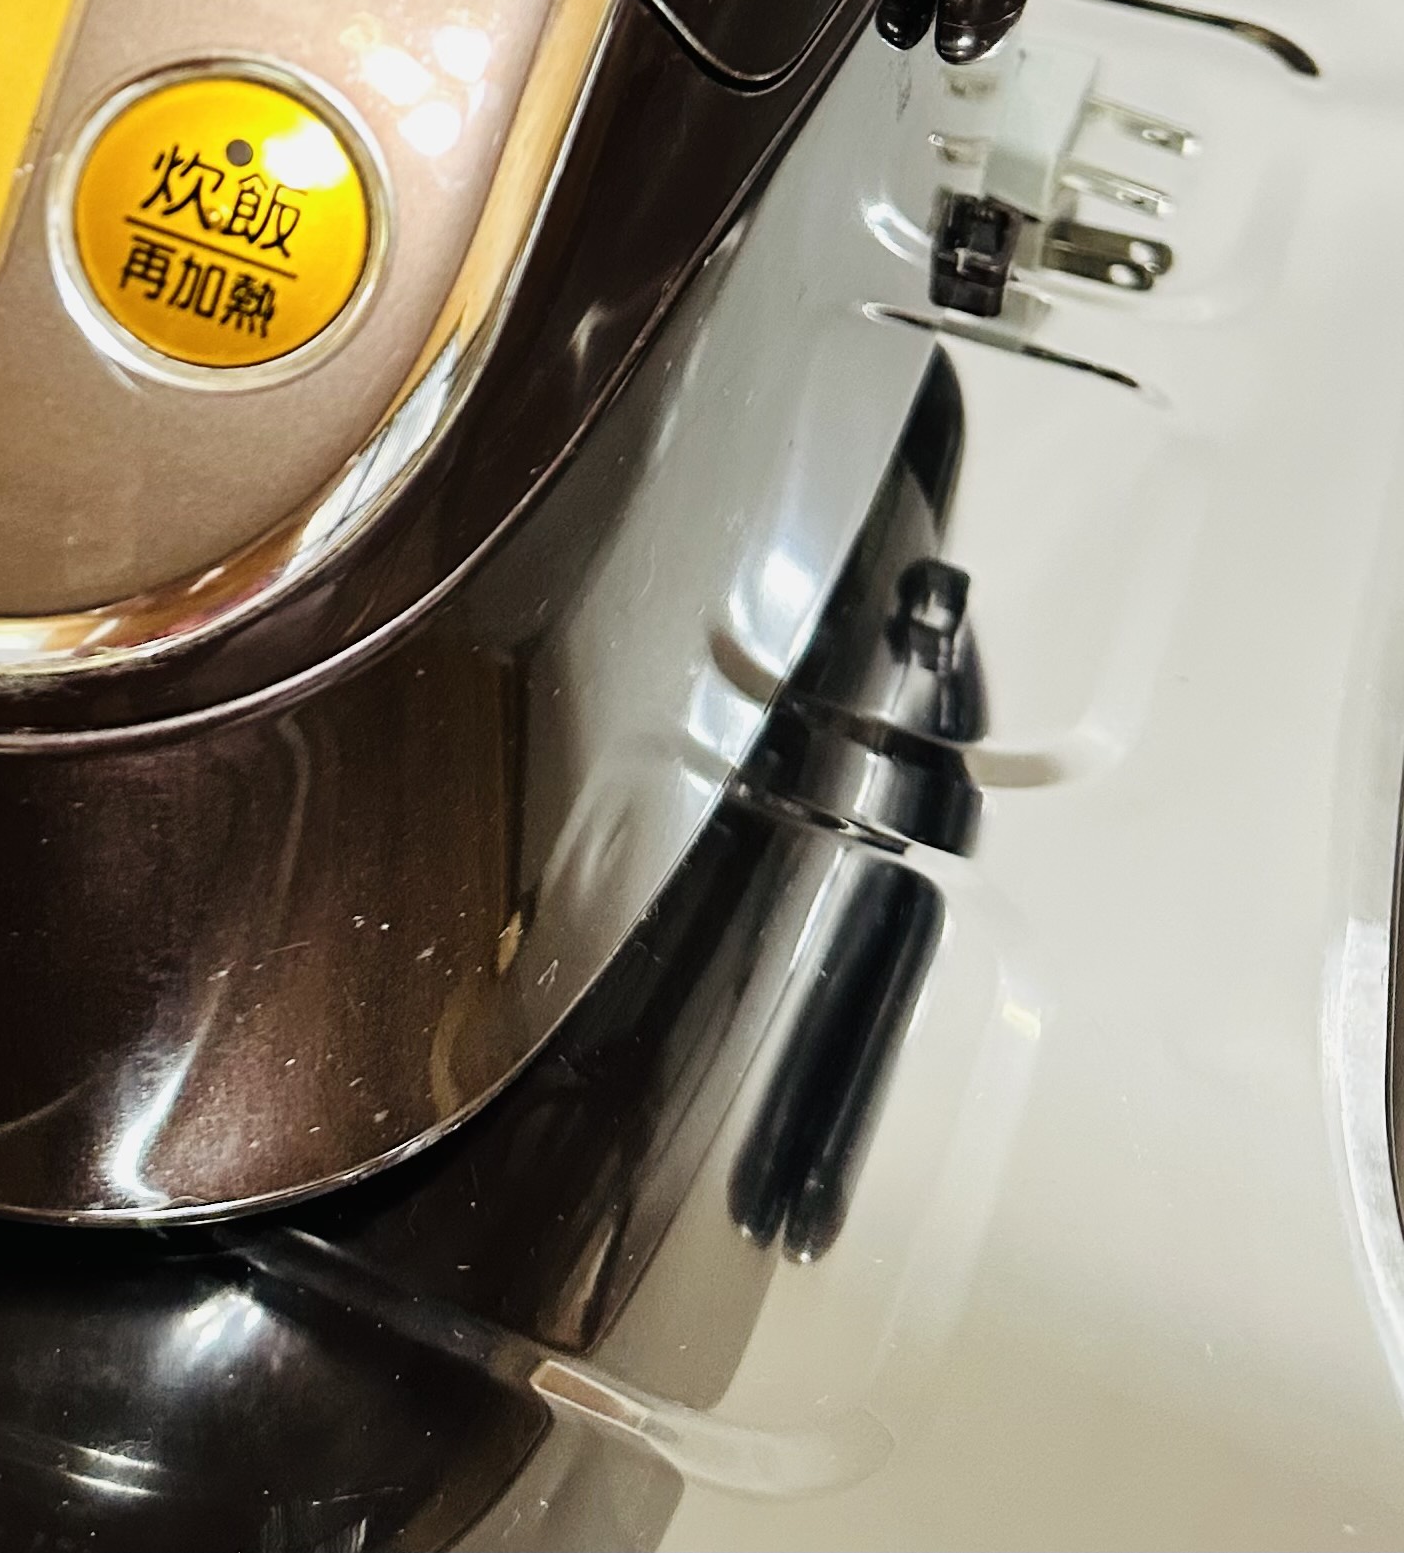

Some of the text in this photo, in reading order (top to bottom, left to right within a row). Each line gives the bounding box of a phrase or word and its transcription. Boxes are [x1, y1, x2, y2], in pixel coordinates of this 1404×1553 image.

[141, 144, 309, 258] 炊飯
[120, 234, 276, 339] 再加熱
